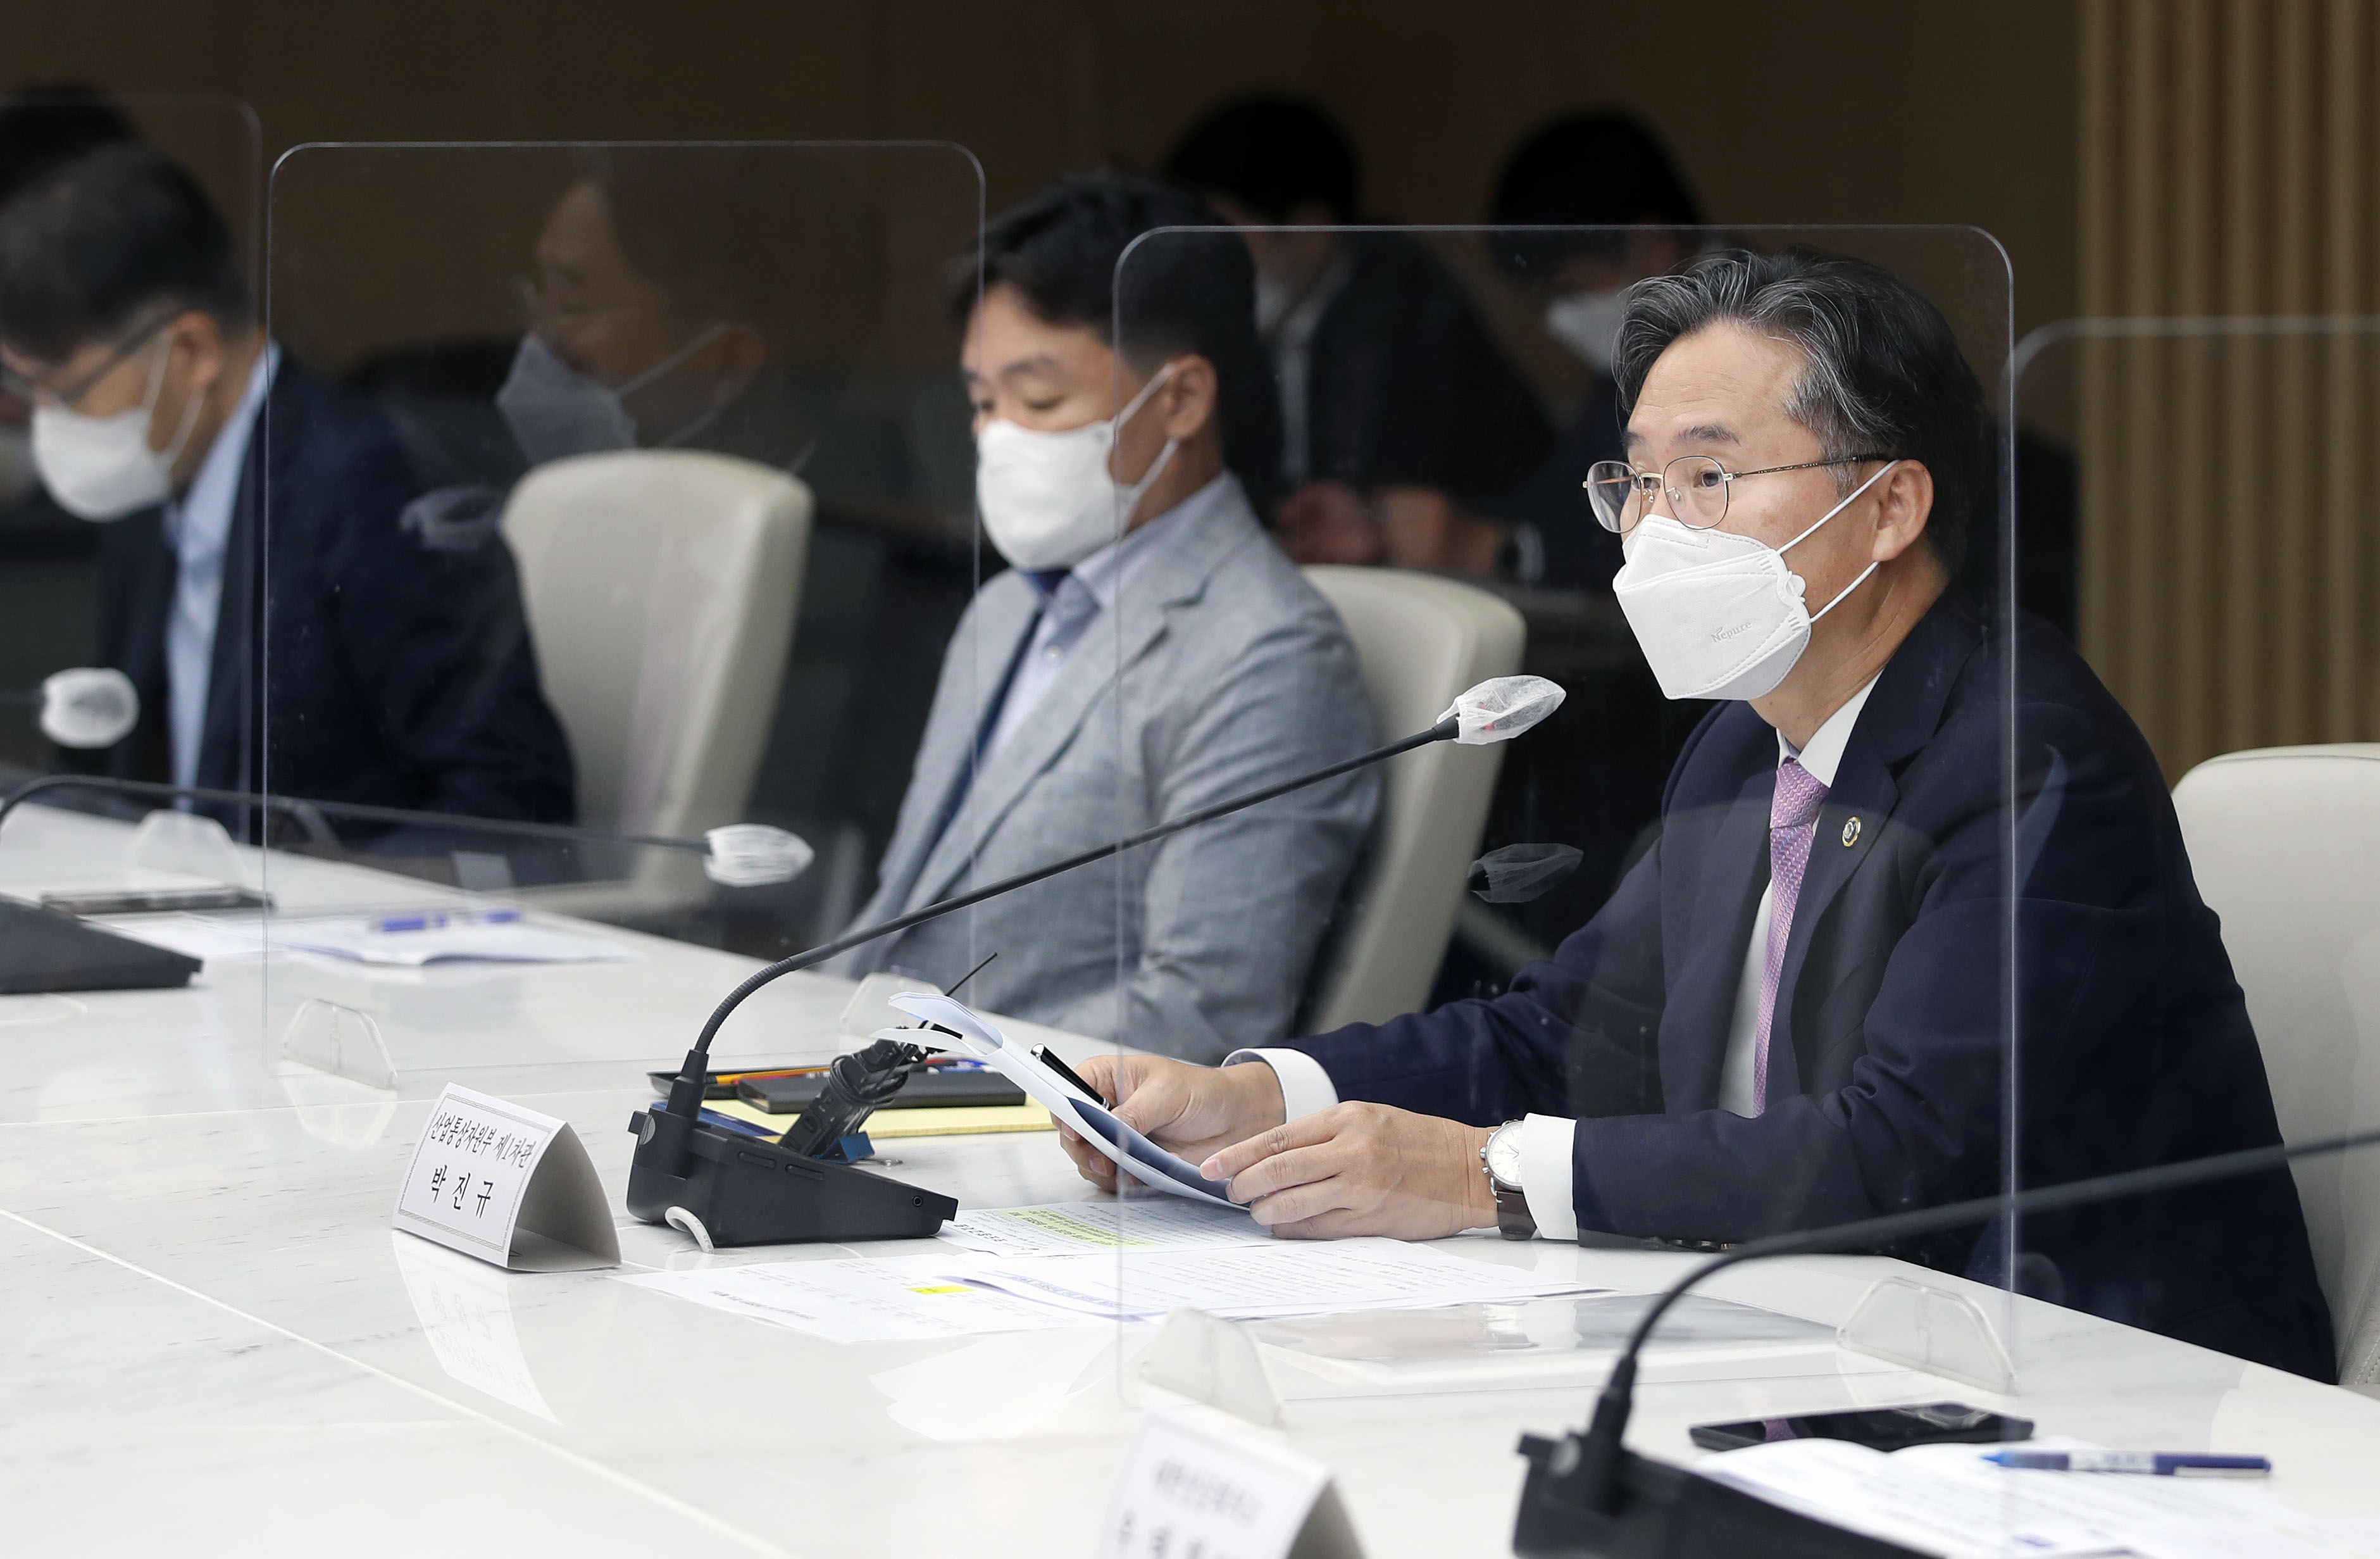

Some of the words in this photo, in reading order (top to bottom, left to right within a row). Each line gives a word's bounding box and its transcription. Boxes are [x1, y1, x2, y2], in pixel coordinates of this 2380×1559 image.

[1710, 622, 1752, 642] Nepure
[430, 1111, 497, 1156] 산업통상자원부
[493, 1132, 537, 1168] 제1차관
